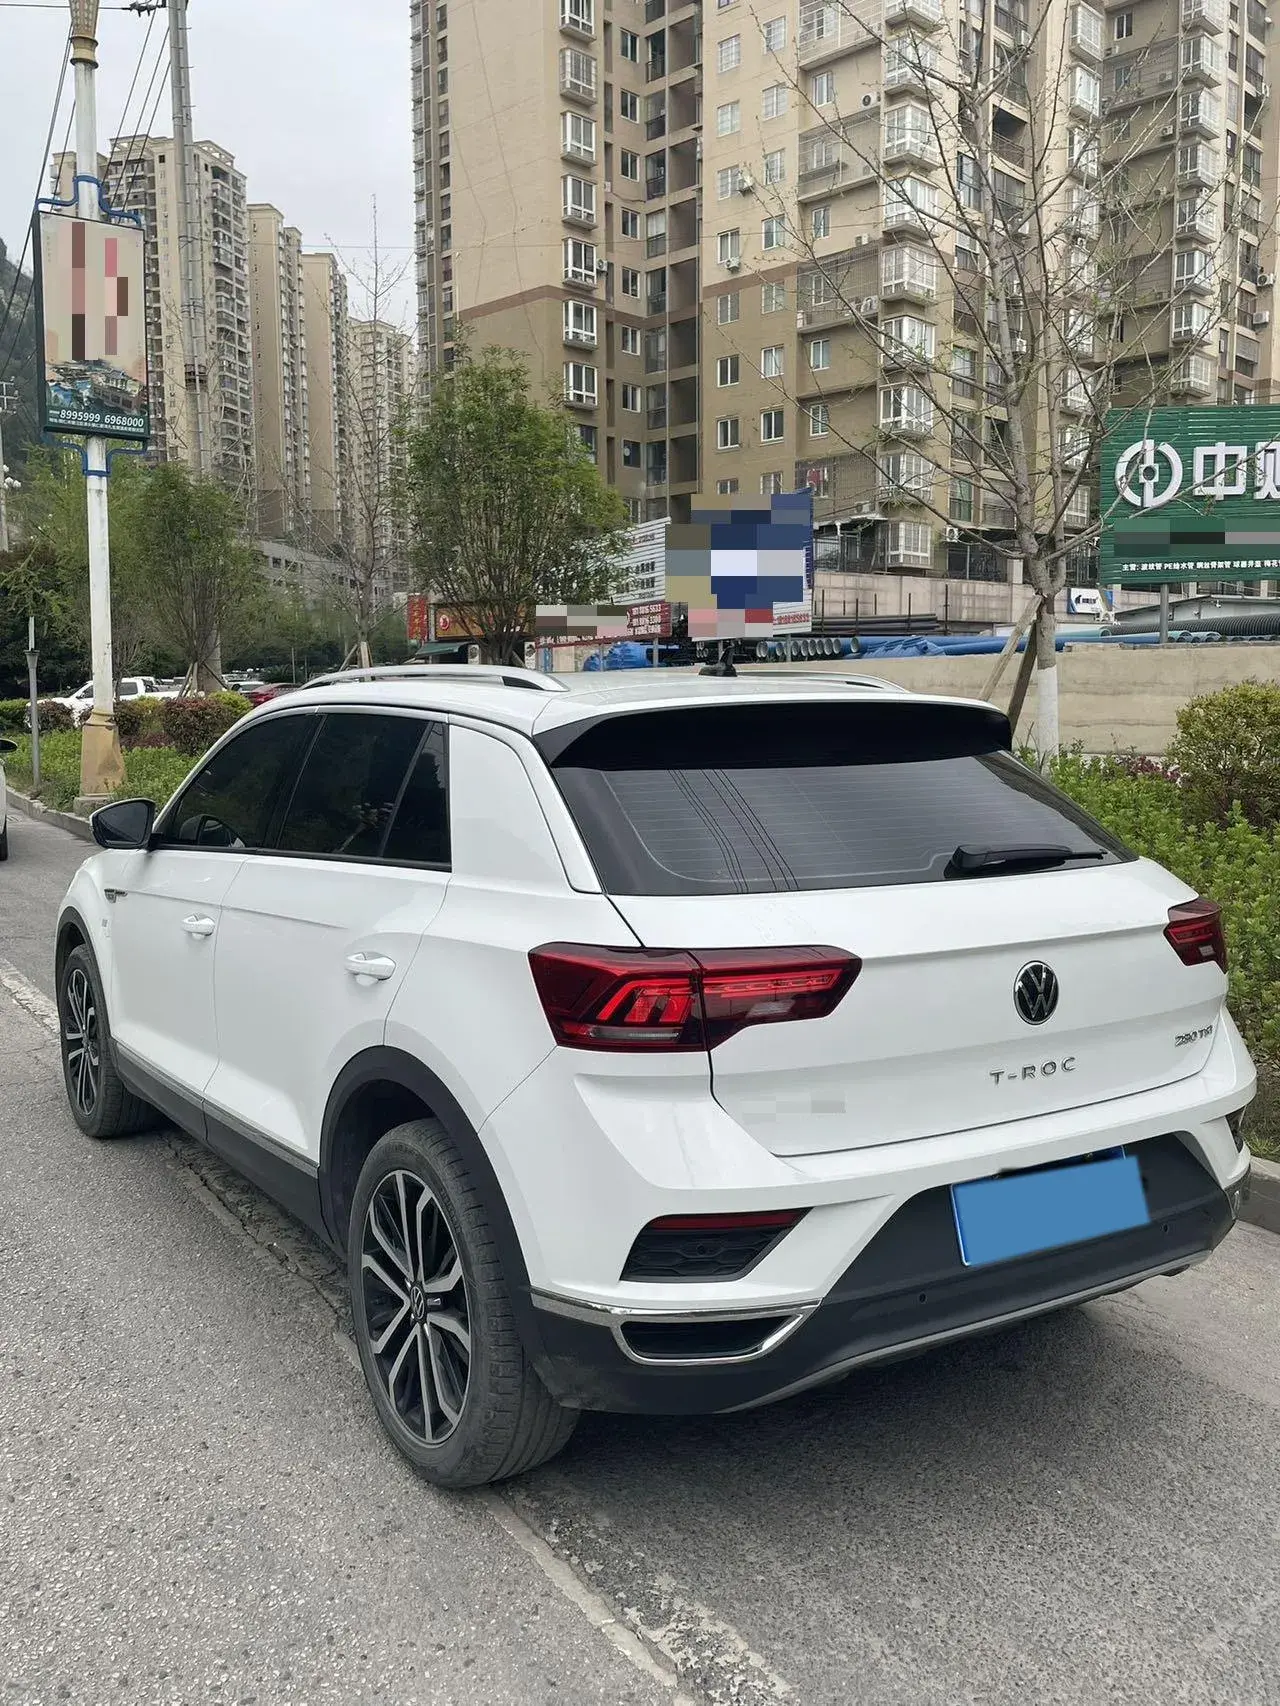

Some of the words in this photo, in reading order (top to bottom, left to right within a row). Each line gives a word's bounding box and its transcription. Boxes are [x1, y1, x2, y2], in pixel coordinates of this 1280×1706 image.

[60, 410, 100, 422] 8995999
[105, 415, 144, 427] 6968000
[989, 1057, 1076, 1085] T-ROC
